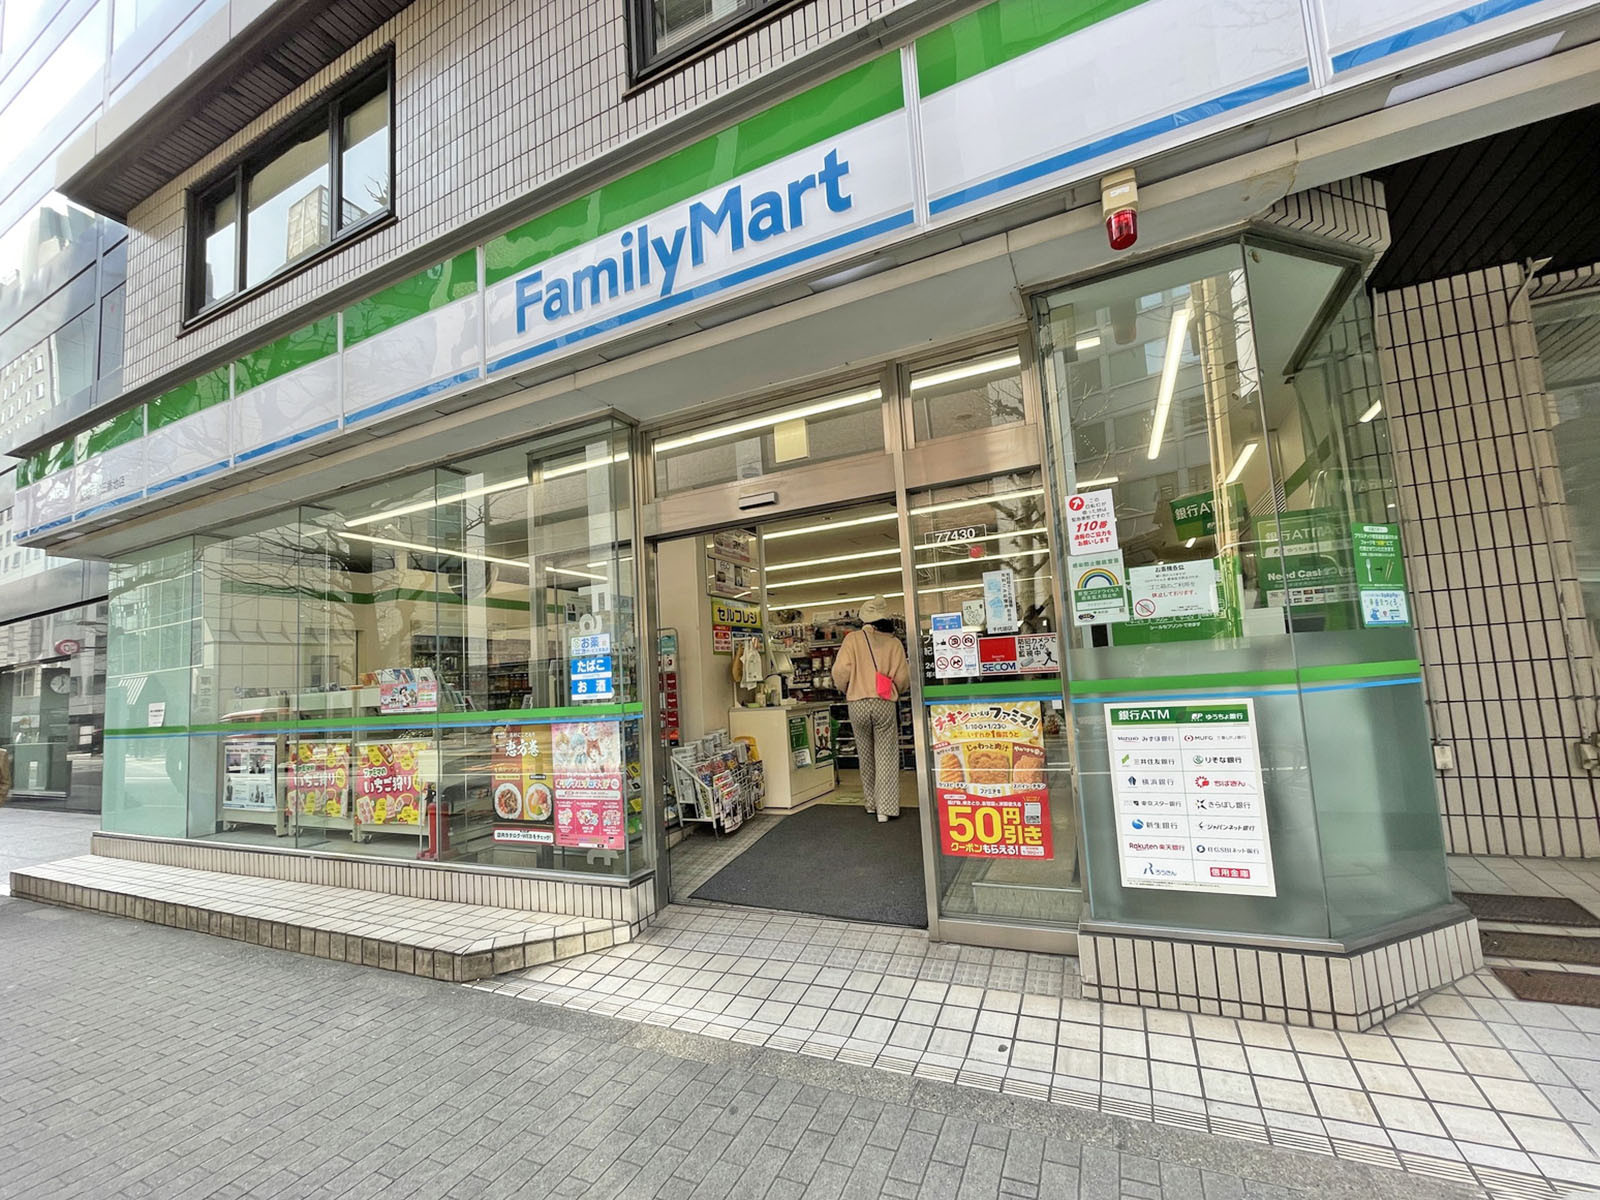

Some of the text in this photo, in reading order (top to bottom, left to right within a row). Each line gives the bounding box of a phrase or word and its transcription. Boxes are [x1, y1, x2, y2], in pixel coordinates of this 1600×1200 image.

[515, 147, 853, 335] FamilyMart
[1077, 520, 1108, 533] 110番
[935, 528, 976, 543] 77430
[1074, 530, 1112, 540] 通報のご協力を
[1078, 537, 1110, 547] お願いします
[1155, 565, 1185, 573] お客様各位
[1267, 571, 1296, 581] Ned
[717, 607, 758, 624] セルフレジ
[581, 637, 599, 649] お薬
[1018, 637, 1056, 645] 防犯カメラで
[1018, 650, 1042, 658] 監視中
[577, 659, 605, 673] たばこ
[982, 662, 1016, 672] SECOM
[577, 680, 606, 694] お酒
[1118, 709, 1170, 720] 銀行ATM
[506, 739, 539, 757] 恵方巻
[1205, 756, 1242, 764] りそな銀行
[363, 767, 388, 777] ファミマの
[364, 776, 412, 793] いちご狩り
[1208, 801, 1251, 809] きらぼし銀行
[1129, 842, 1158, 851] Rakuten
[1211, 868, 1250, 878] 信用金庫
